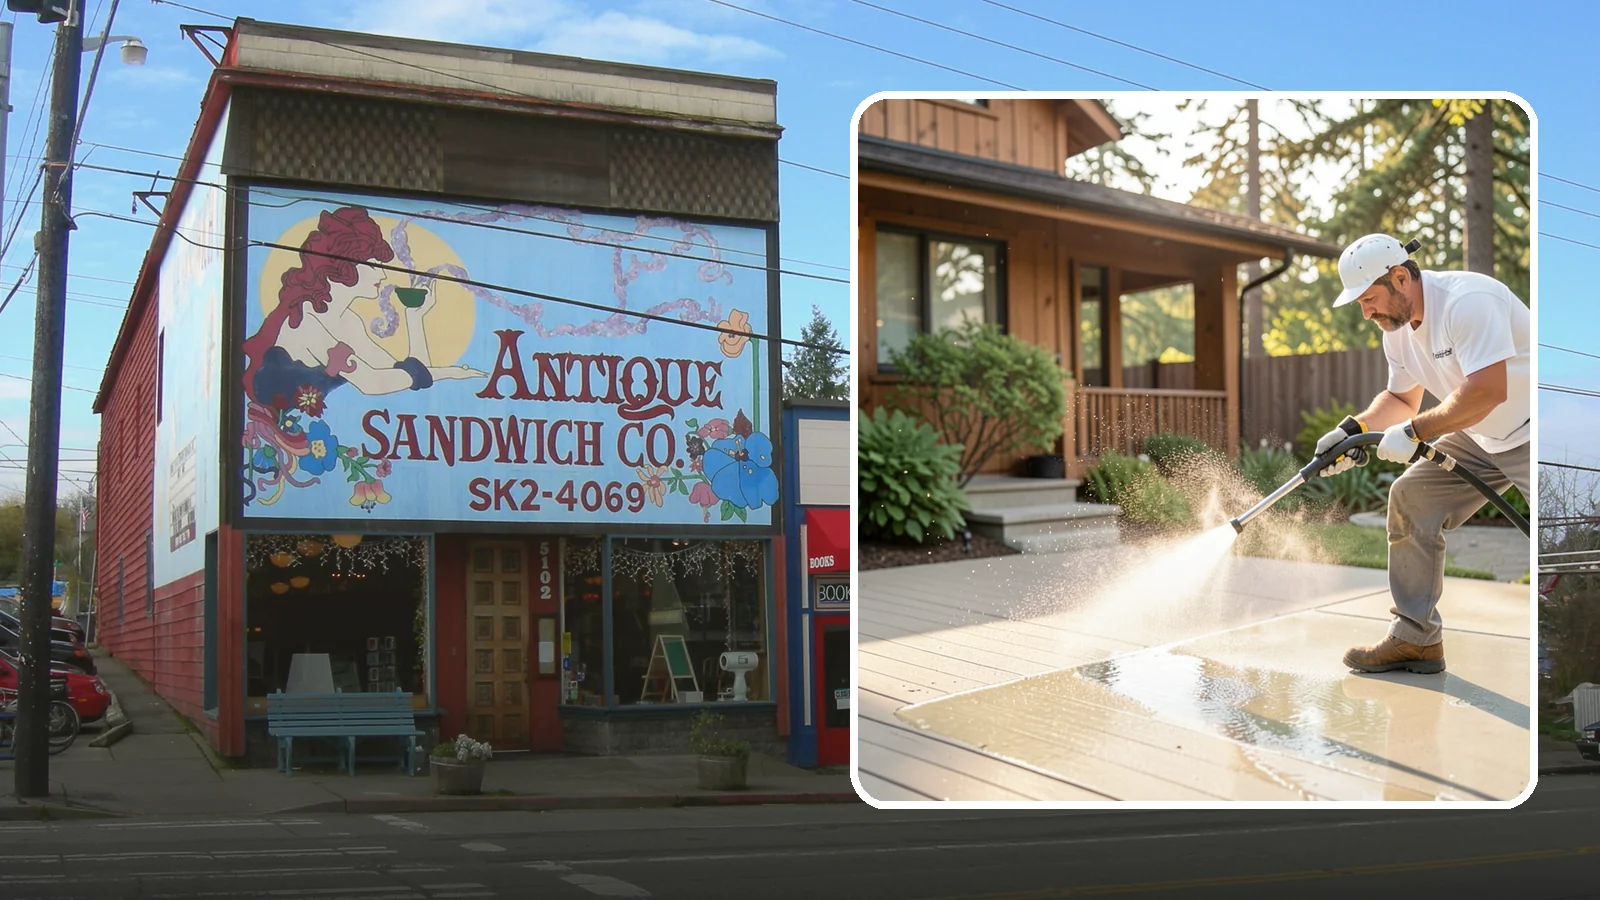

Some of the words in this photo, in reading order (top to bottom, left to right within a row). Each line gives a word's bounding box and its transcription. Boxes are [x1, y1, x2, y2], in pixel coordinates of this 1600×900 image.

[476, 329, 723, 420] ANTIQUE
[361, 408, 604, 467] SANDWICH
[617, 421, 685, 469] CO.
[468, 477, 646, 512] SK2-4069
[539, 542, 551, 600] 5102
[809, 555, 835, 569] BOOKS
